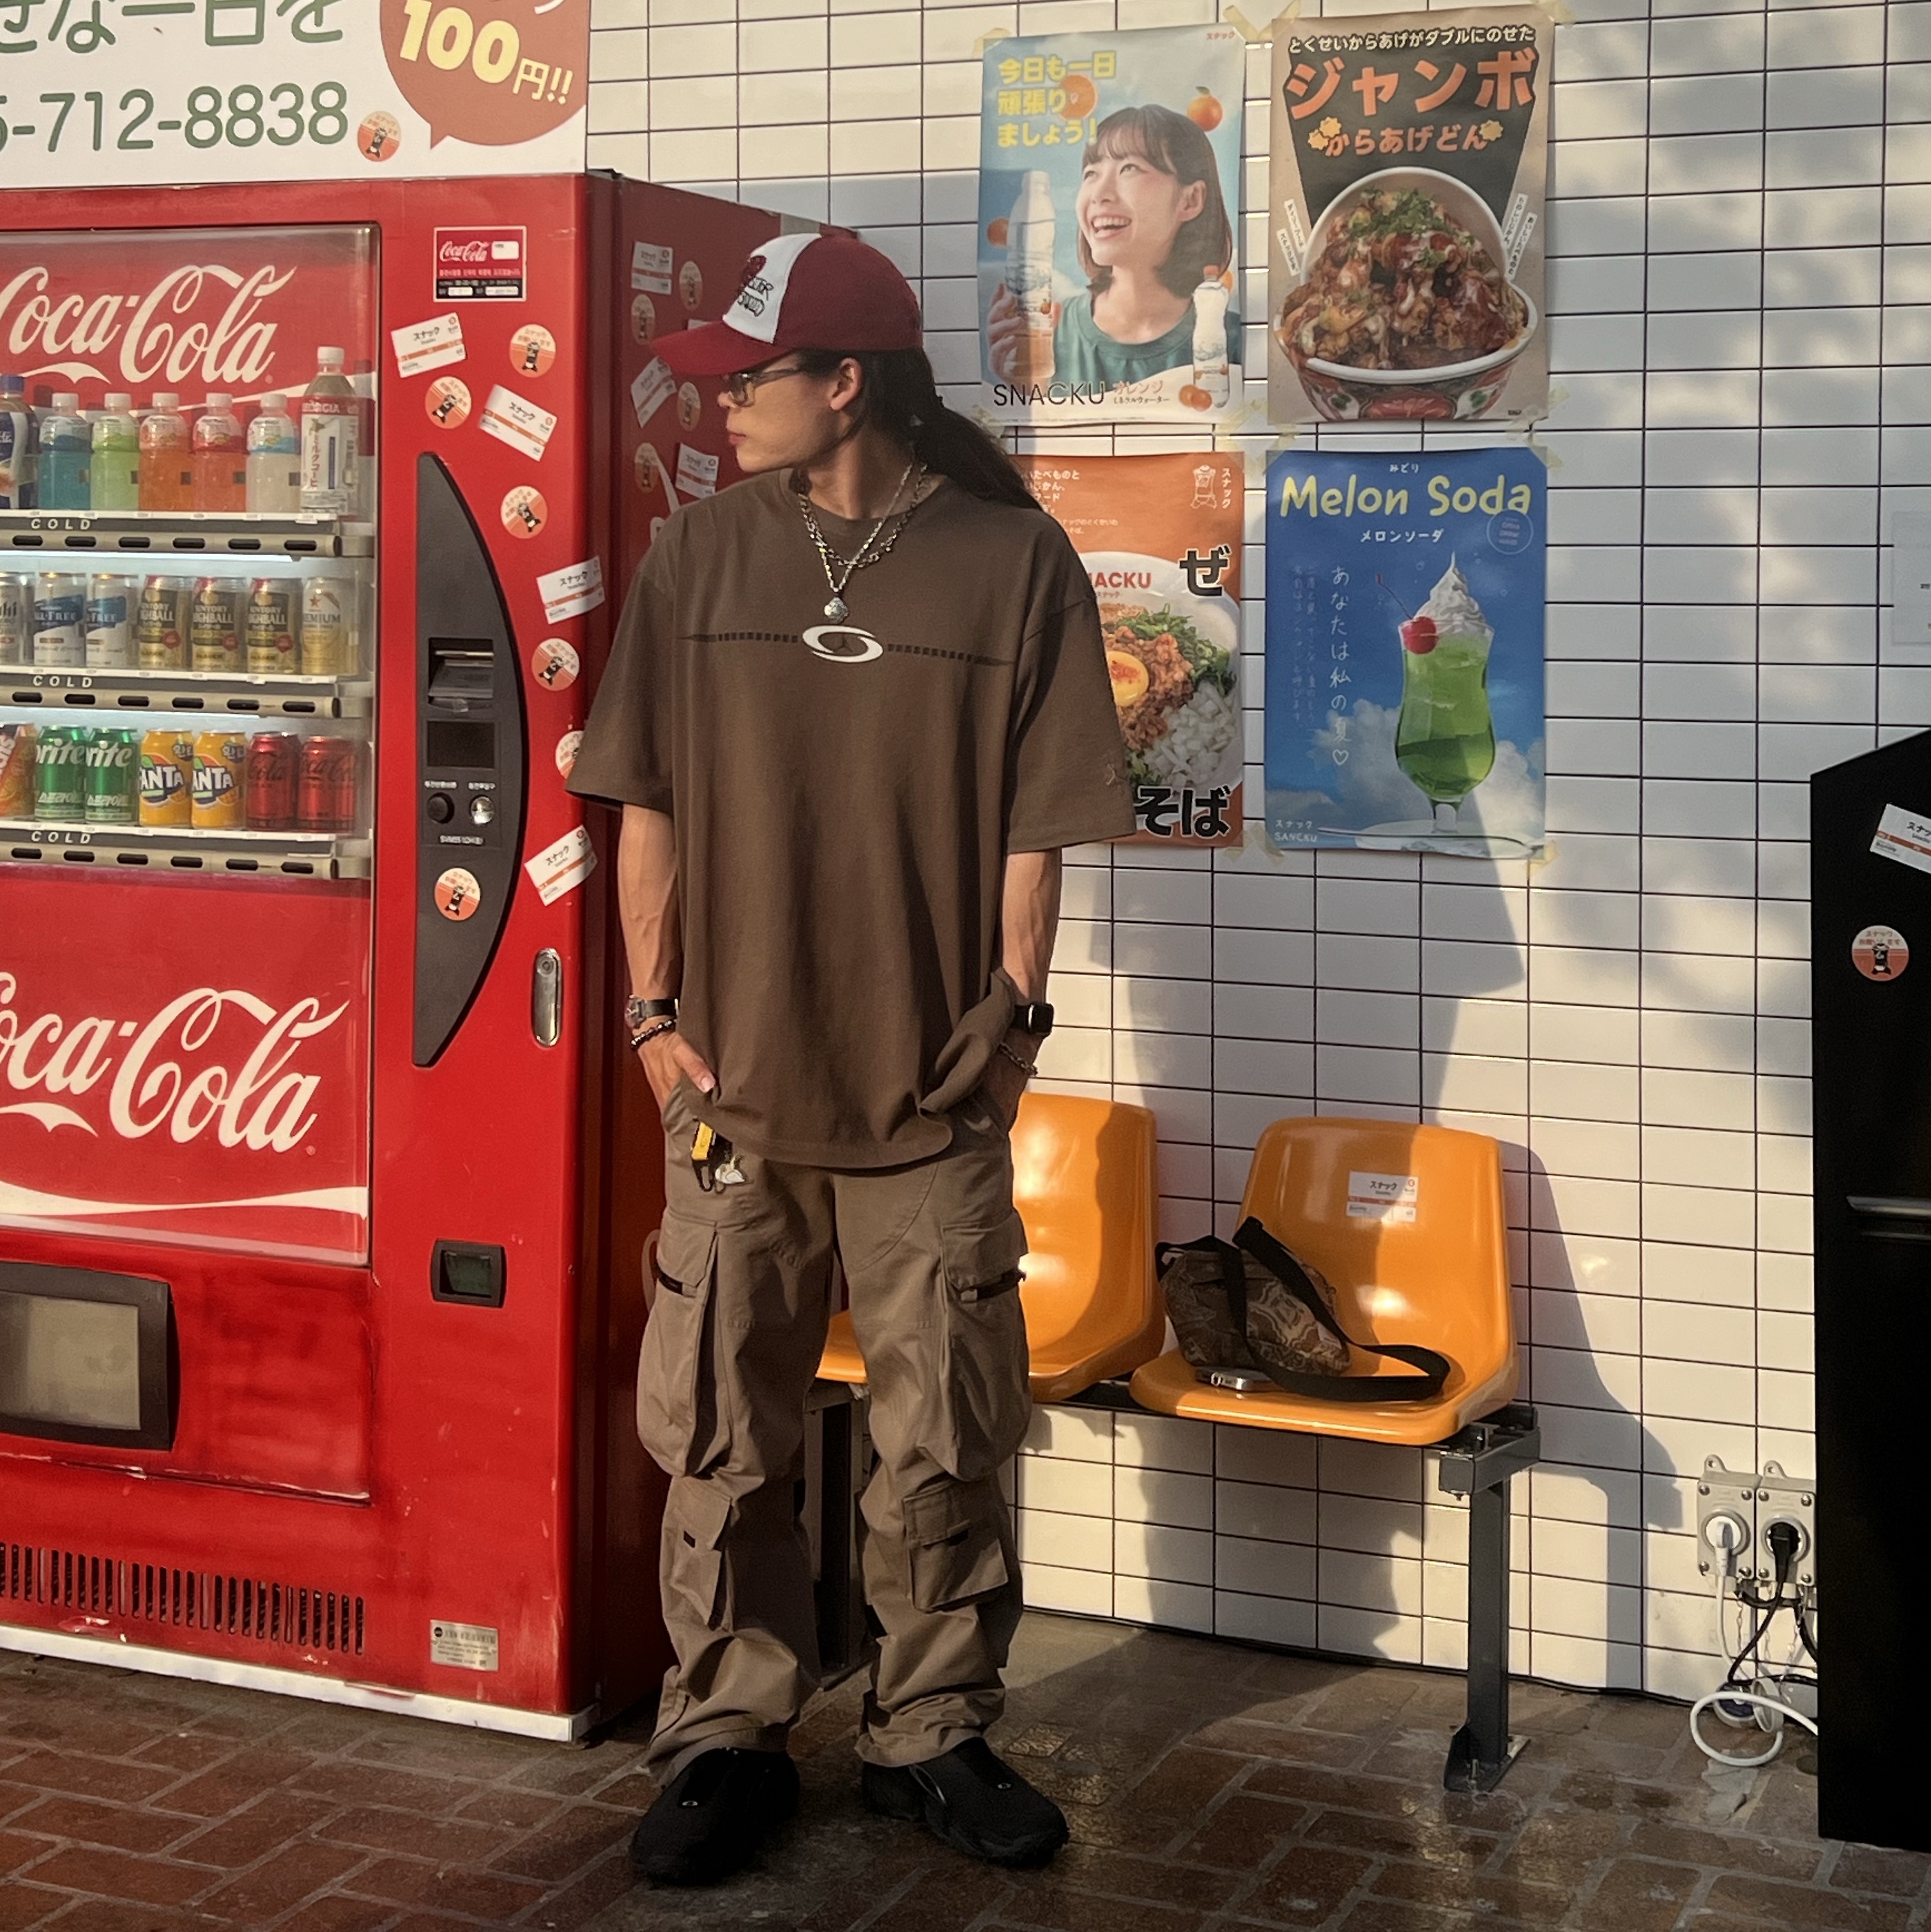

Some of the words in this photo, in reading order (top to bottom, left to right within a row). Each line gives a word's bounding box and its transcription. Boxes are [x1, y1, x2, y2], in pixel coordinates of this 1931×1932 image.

[1289, 25, 1536, 54] とくせいからあげがダブルにのせた
[998, 51, 1116, 84] 今日も一日
[1286, 47, 1537, 120] ジャンボ
[997, 88, 1067, 116] 頑張り
[0, 81, 347, 151] -712-8838
[1325, 124, 1488, 157] からあげどん
[439, 240, 490, 262] Coca-Cola
[413, 326, 439, 342] スナック
[993, 381, 1104, 407] SNACKU
[1113, 380, 1163, 395] オレンジ
[508, 401, 535, 422] スナック
[1389, 463, 1420, 473] みどり
[1221, 467, 1232, 510] スナック
[1280, 474, 1409, 518] Melon
[1428, 474, 1532, 517] Soda
[31, 519, 91, 530] COLD
[1360, 528, 1445, 543] メロンソーダ
[560, 571, 588, 586] スナック
[1179, 544, 1232, 597] ぜ
[33, 675, 92, 687] COLD
[139, 766, 183, 790] ANTA
[192, 767, 233, 790] ANTA
[1135, 786, 1231, 838] そば
[1276, 820, 1313, 830] スナック
[31, 832, 91, 843] COLD
[546, 845, 570, 866] スナック
[1370, 1181, 1398, 1190] スナック
